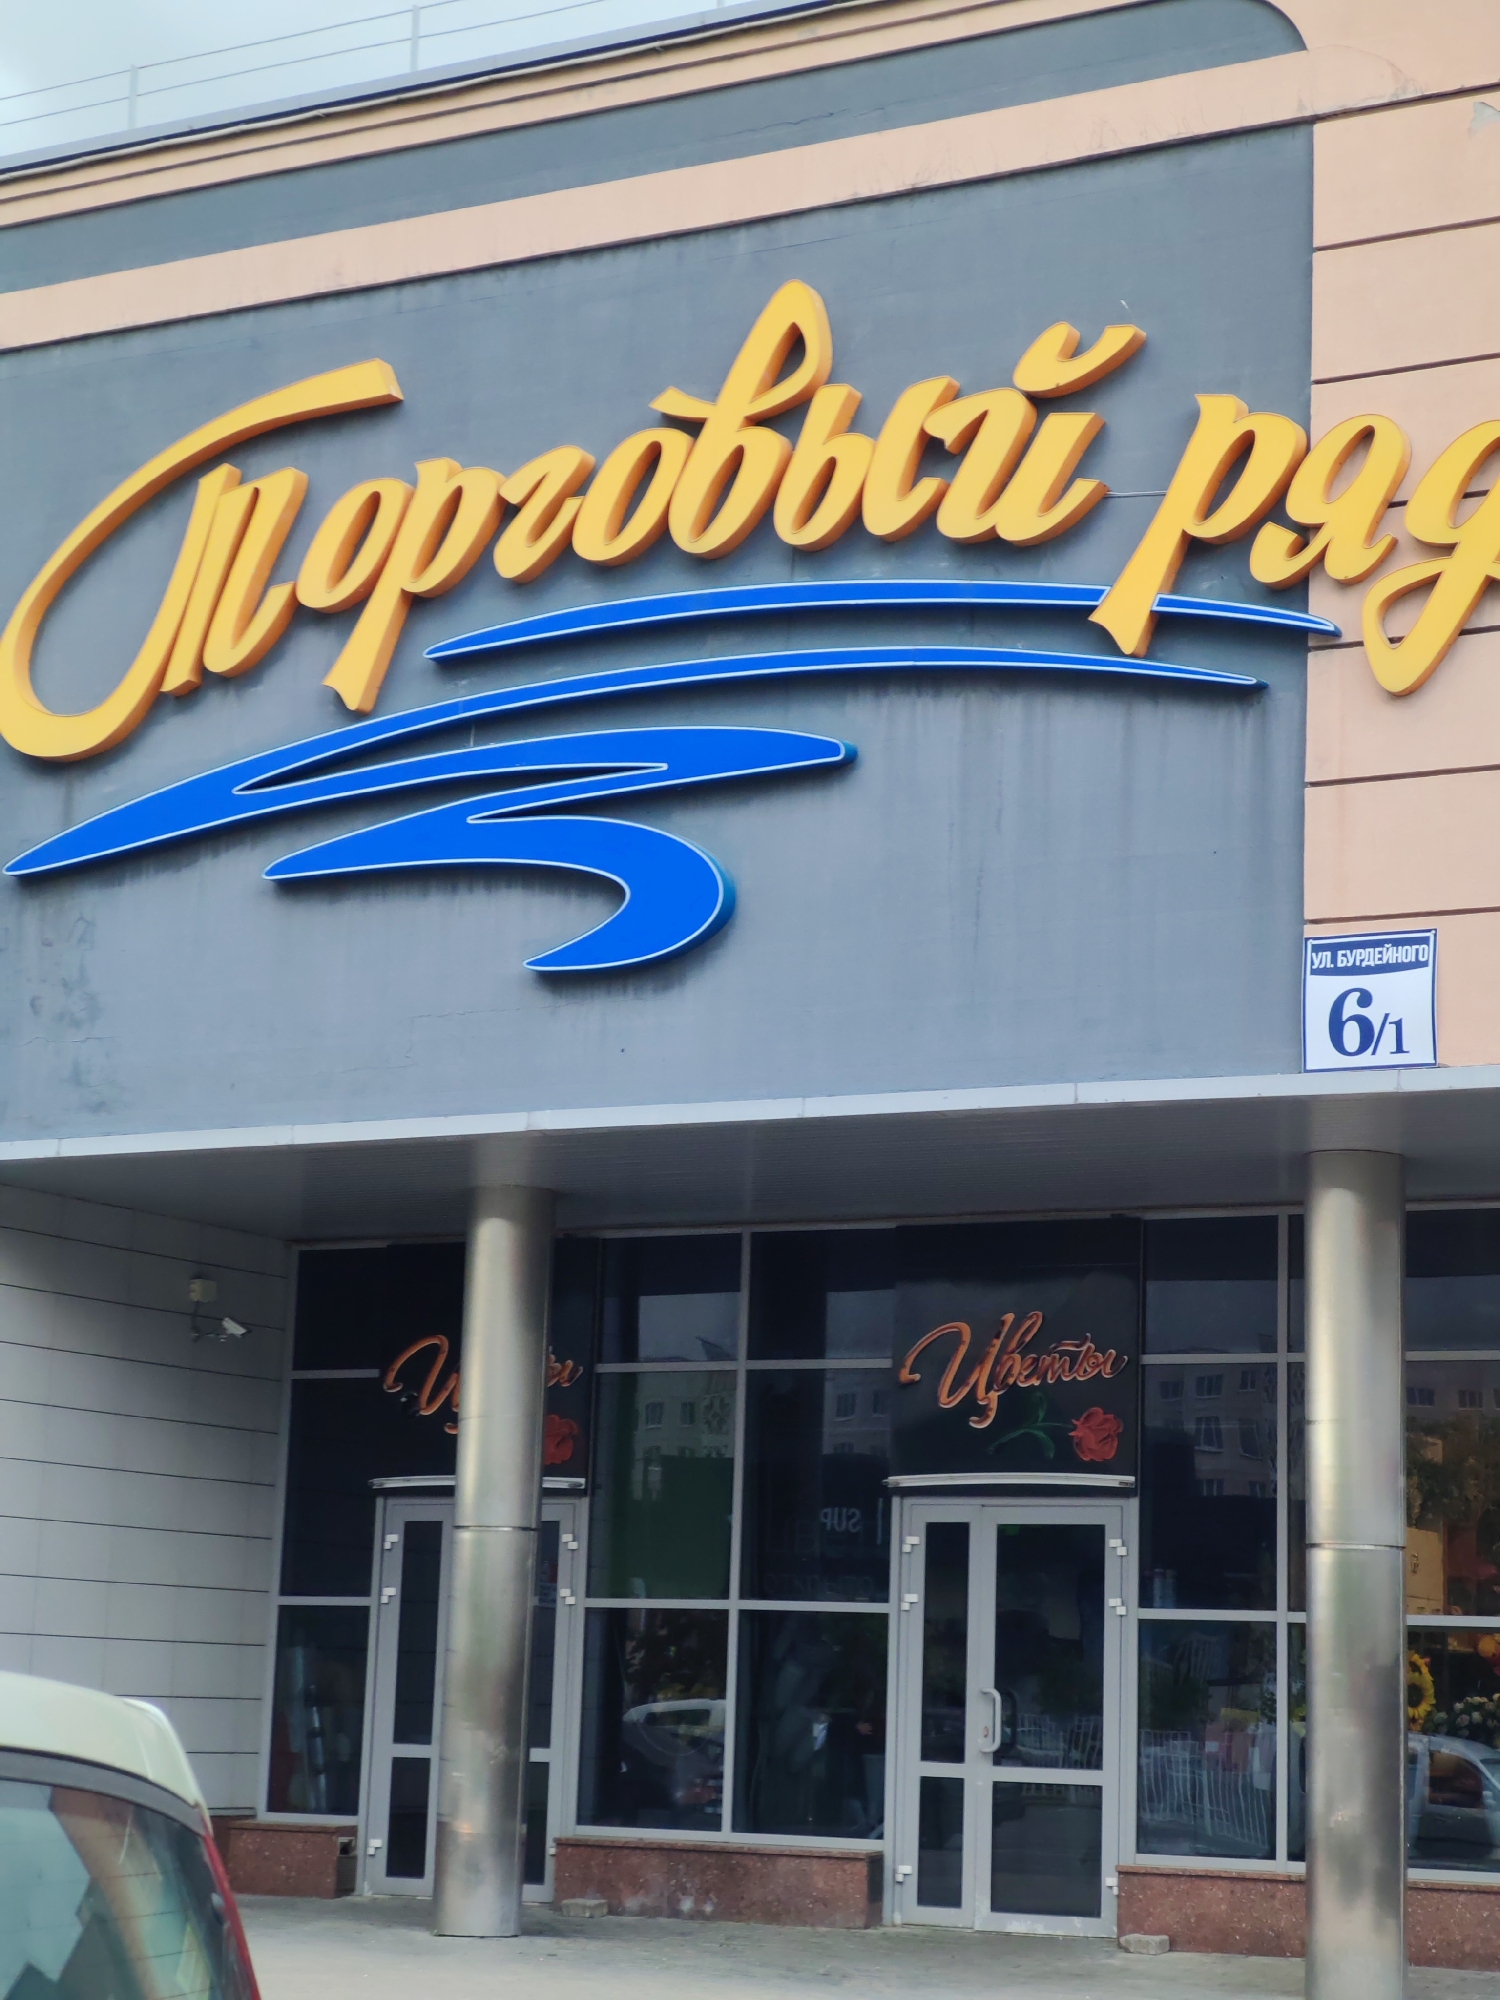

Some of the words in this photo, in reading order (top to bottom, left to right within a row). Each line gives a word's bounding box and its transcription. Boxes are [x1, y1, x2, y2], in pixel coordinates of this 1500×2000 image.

[0, 279, 1146, 762] Торговый
[1088, 393, 1500, 696] ряд
[1311, 951, 1334, 969] УЛ.
[1337, 943, 1429, 967] БУРДЕЙНОГО
[1328, 987, 1410, 1057] 6/1
